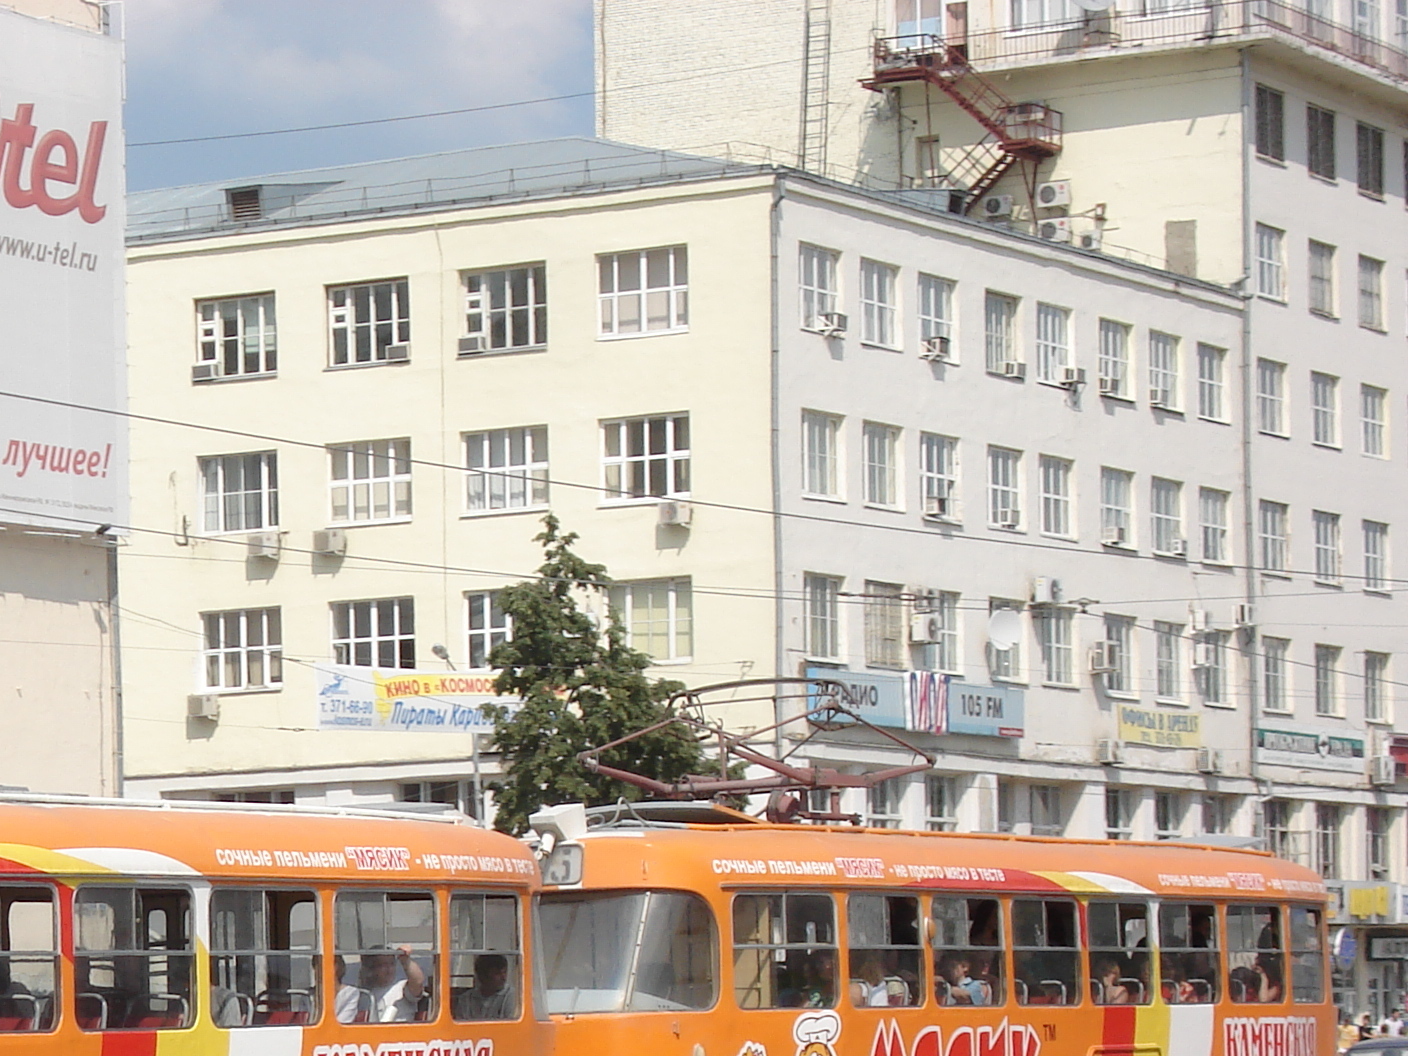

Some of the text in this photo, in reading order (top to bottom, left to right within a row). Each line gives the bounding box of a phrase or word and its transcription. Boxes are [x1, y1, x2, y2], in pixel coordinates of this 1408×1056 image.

[2, 438, 113, 478] лучшее!
[384, 680, 421, 698] КИНО
[390, 701, 448, 729] Пираты
[960, 693, 1004, 719] 105 FM
[216, 848, 271, 867] сочные
[274, 850, 348, 869] пельмени
[440, 854, 478, 875] просто
[712, 858, 766, 875] сочные
[768, 859, 836, 876] пельмени
[908, 864, 944, 882] просто
